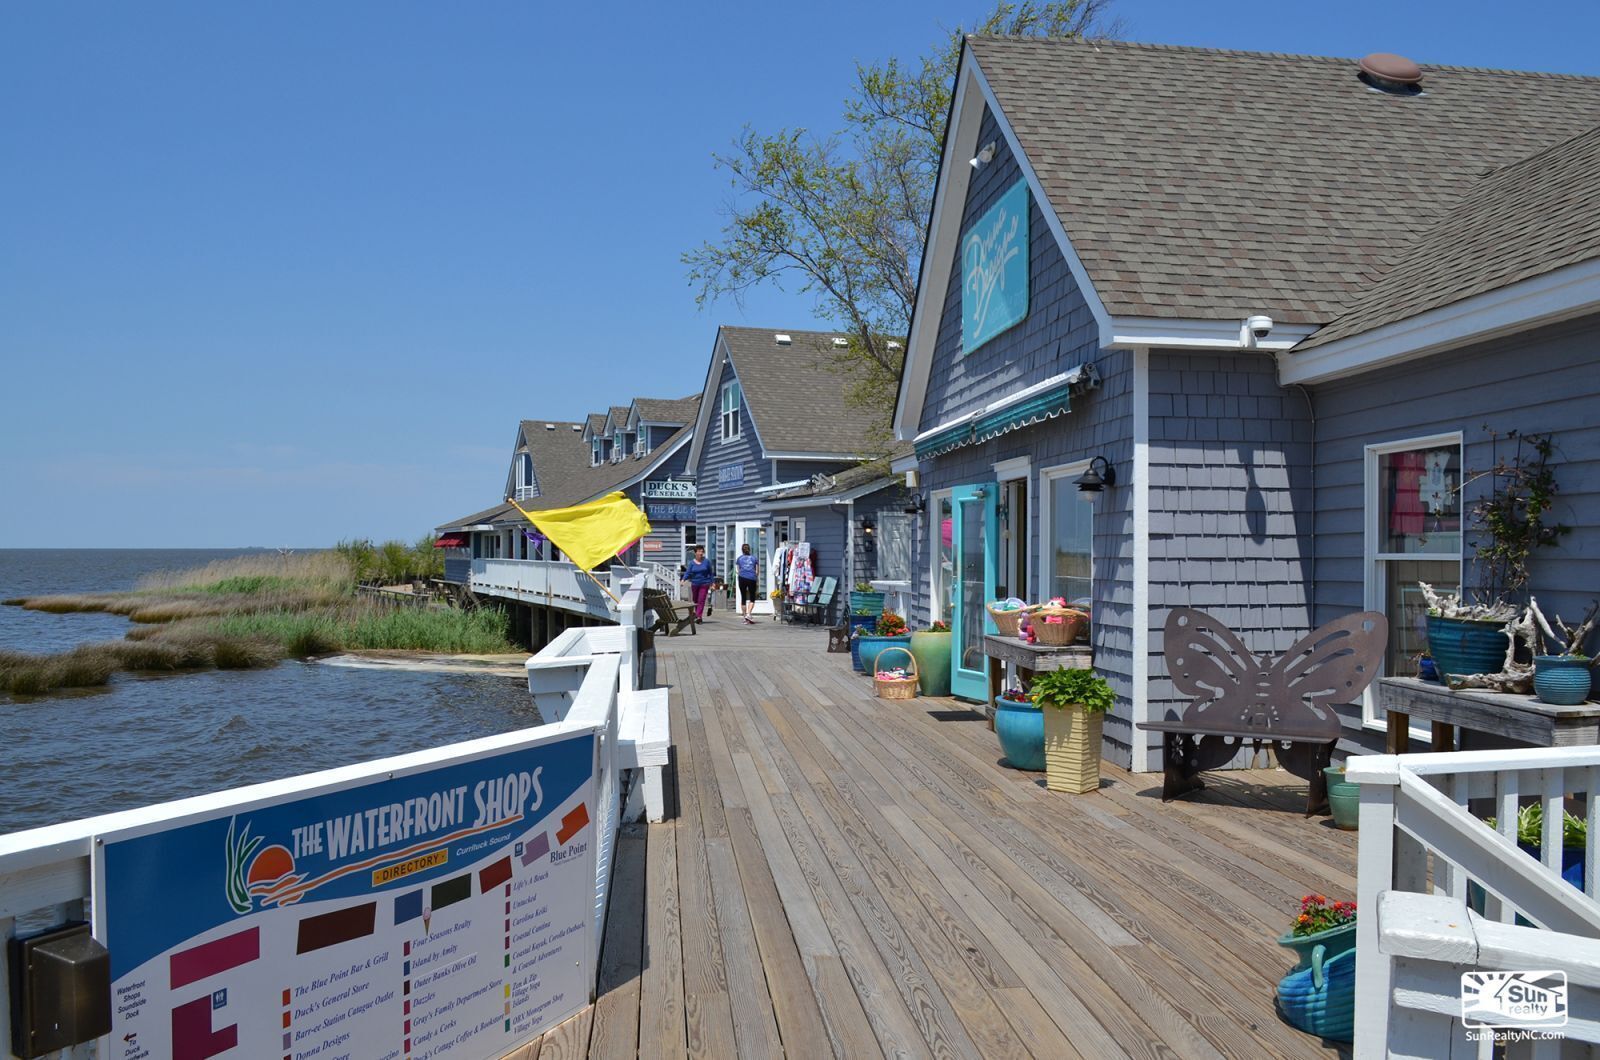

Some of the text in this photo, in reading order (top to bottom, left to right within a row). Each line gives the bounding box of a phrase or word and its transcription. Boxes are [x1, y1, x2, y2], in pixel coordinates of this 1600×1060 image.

[648, 482, 688, 490] DUCK'S
[649, 505, 666, 514] THE
[668, 505, 688, 514] BLUE
[292, 766, 543, 861] THE WATERFRONT SHOPS
[456, 833, 512, 856] Currituck Sound
[550, 850, 566, 863] Blue
[568, 841, 587, 857] Point
[382, 853, 439, 880] DIRECTORY
[514, 879, 528, 890] Life's
[534, 871, 549, 882] Beach
[512, 910, 534, 927] Carolina
[412, 920, 472, 950] Four Seasons Realty
[512, 927, 531, 943] Coastal
[412, 952, 431, 969] Island
[432, 952, 440, 961] by
[512, 944, 531, 960] Coastal
[414, 955, 477, 989] Outer Banks Olive Oil
[518, 958, 536, 972] Coastal
[295, 952, 389, 998] The Blue Point Bar & Grill
[117, 980, 145, 995] Waterfront
[118, 998, 147, 1013] Soundside
[124, 992, 140, 1002] Shops
[295, 982, 370, 1020] Duck's General Store
[413, 991, 436, 1008] Dazzles
[413, 979, 502, 1027] Gray's Family Department Store
[126, 1010, 139, 1020] Dock
[295, 1024, 321, 1041] Barr-ee
[322, 1013, 346, 1028] Station
[375, 991, 394, 1006] Outlet
[413, 1030, 433, 1046] Candy
[440, 1020, 457, 1033] Corks
[456, 1030, 473, 1043] Coffee
[474, 1025, 478, 1034] &
[125, 1046, 140, 1056] Duck
[295, 1032, 350, 1060] Donna Designs
